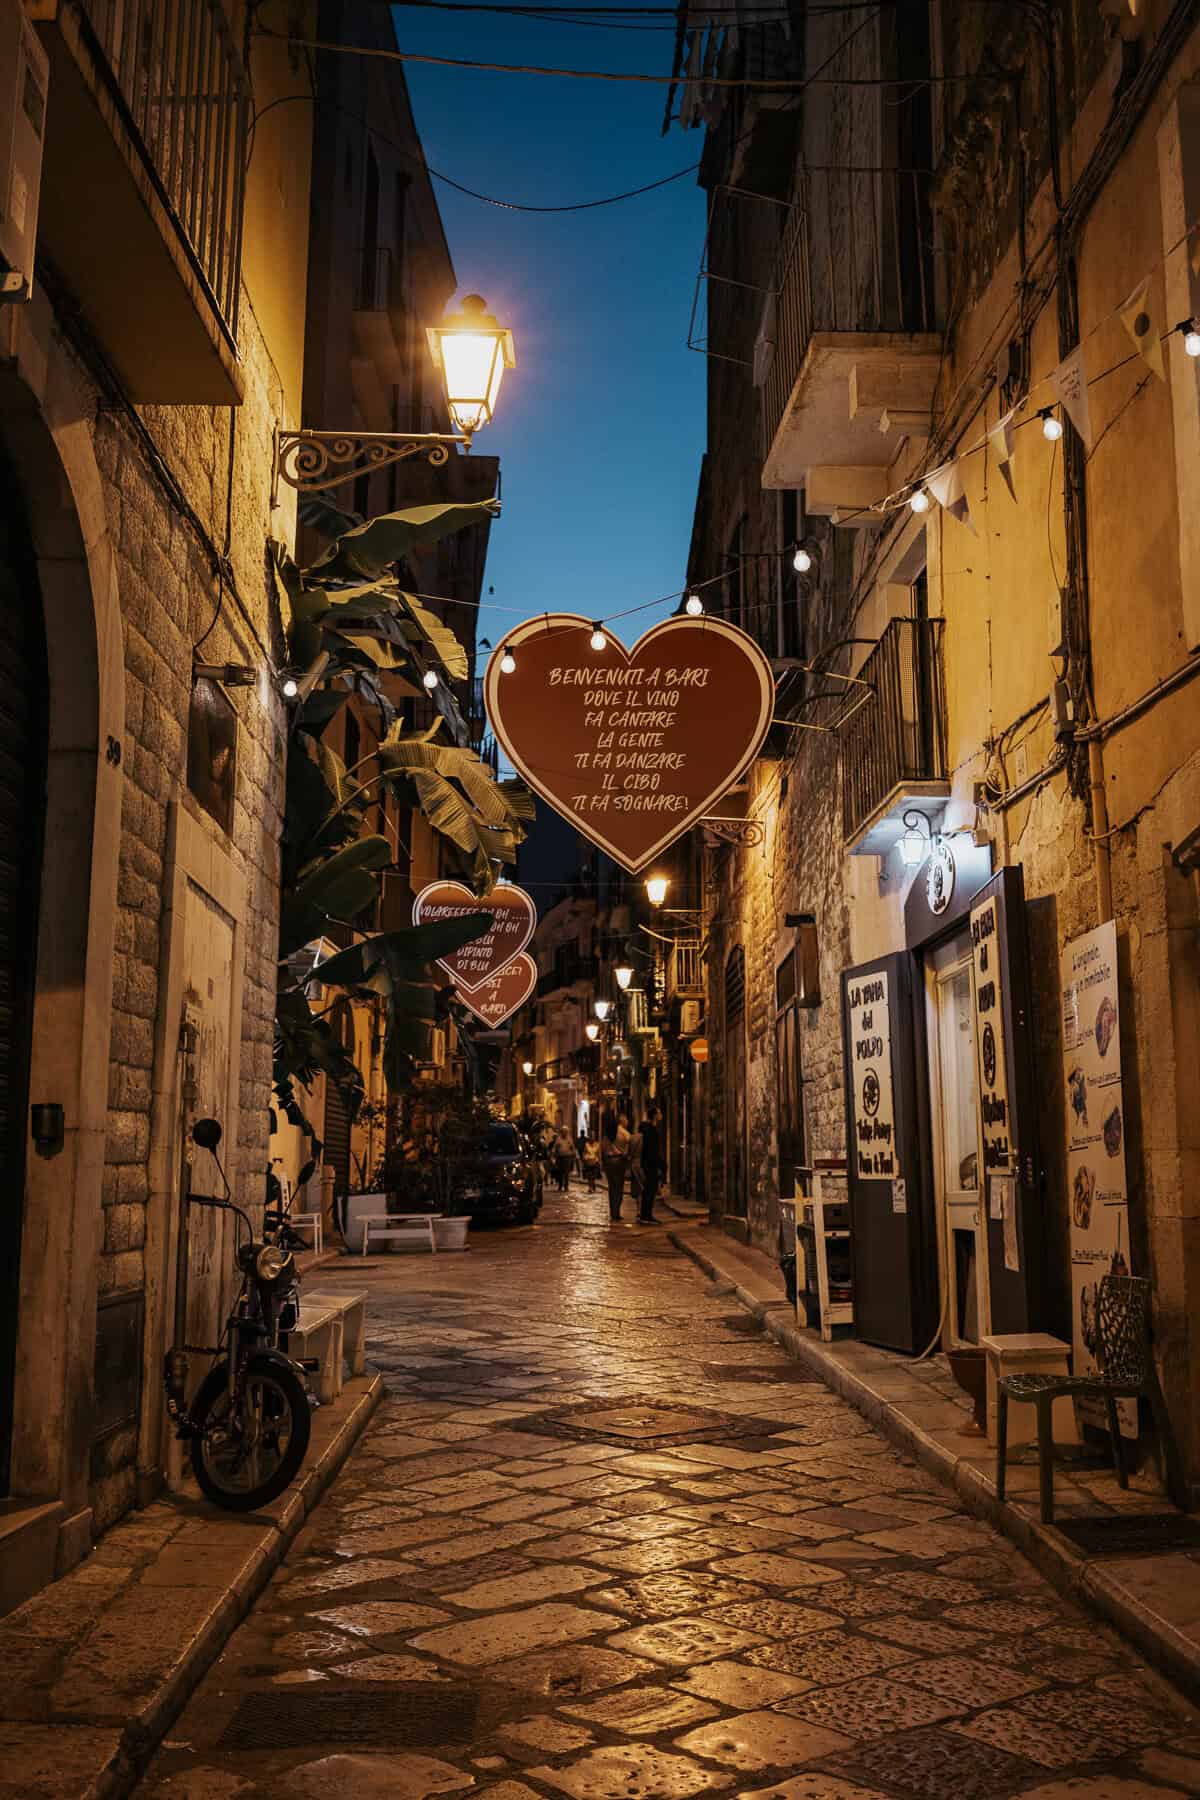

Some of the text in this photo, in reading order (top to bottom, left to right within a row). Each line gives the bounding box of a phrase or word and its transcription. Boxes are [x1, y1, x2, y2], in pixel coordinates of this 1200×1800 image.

[550, 667, 711, 687] BENVENUTI A BARI
[584, 690, 679, 707] DOVE IL VINO
[584, 711, 676, 728] FA CANTARE
[598, 731, 664, 748] LA GENTE
[574, 753, 686, 769] TI FA DANZARE
[602, 774, 660, 790] IL CIBO
[572, 795, 689, 811] TI FA SOGNARE!
[505, 923, 520, 934] OH
[457, 960, 490, 971] DI BLU
[489, 990, 498, 1002] A
[862, 1010, 873, 1032] del
[856, 1037, 883, 1061] POLPO
